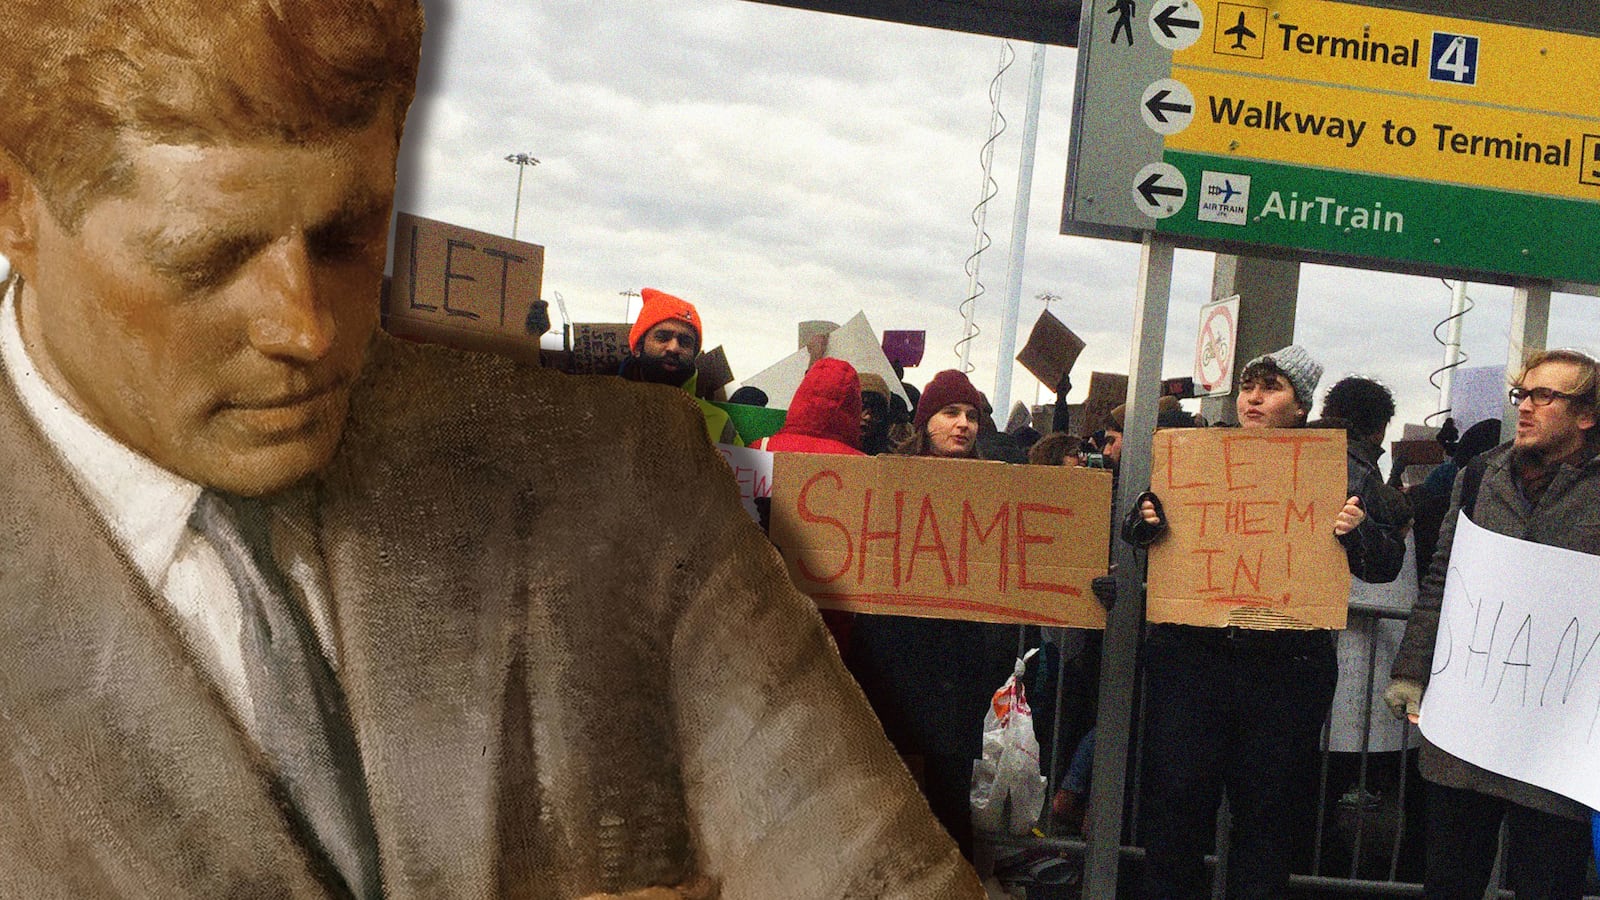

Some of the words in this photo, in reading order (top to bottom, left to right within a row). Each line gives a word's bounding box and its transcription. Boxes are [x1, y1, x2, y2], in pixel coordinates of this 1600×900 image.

[1278, 23, 1419, 68] Terminal
[1437, 36, 1469, 81] 4
[1209, 96, 1366, 148] Walkway
[1382, 118, 1416, 147] to
[1433, 123, 1571, 167] Terminal
[1259, 190, 1404, 233] AirTrain
[410, 225, 528, 326] LET
[1166, 434, 1331, 495] LET
[797, 470, 1082, 597] SHAME
[1184, 499, 1316, 539] THEM
